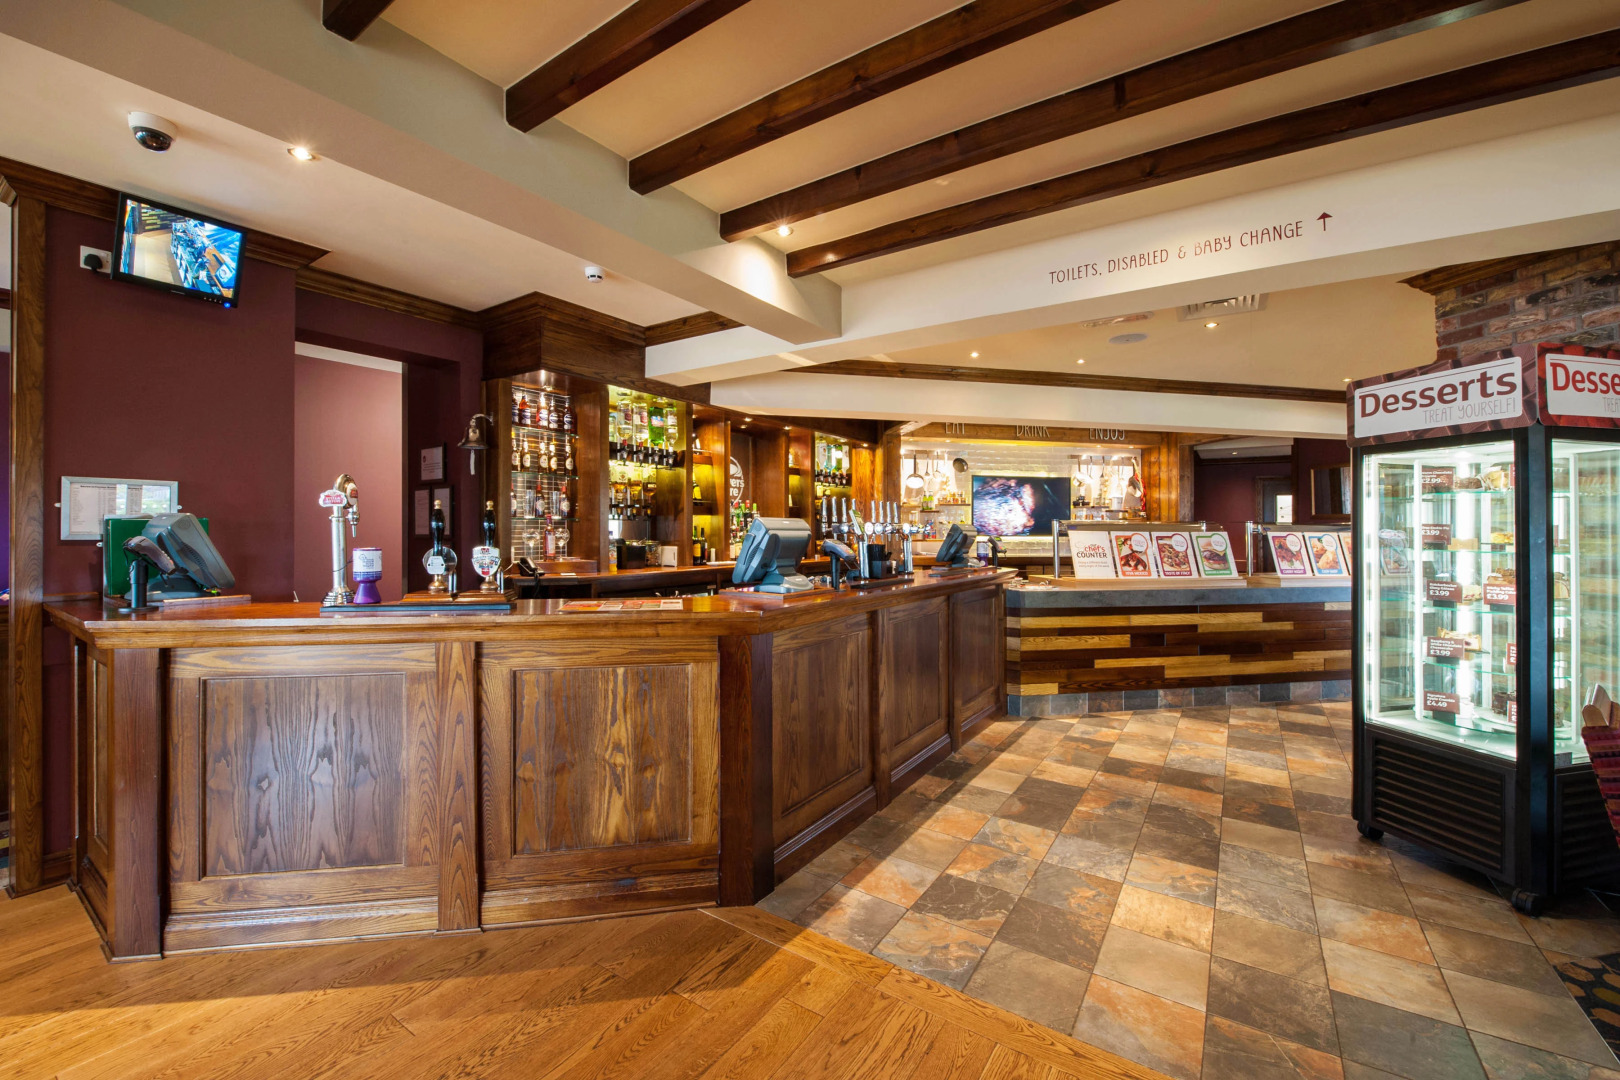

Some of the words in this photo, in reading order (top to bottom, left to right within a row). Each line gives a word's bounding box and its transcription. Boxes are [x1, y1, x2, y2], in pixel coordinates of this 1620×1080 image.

[1049, 262, 1102, 285] TOILETS,
[1108, 248, 1169, 273] DISABLED
[1177, 245, 1187, 259] &
[1194, 235, 1232, 257] BABY
[1240, 220, 1303, 247] CHANGE
[1358, 370, 1518, 418] Desserts
[1423, 406, 1453, 425] TREAT
[1457, 397, 1517, 420] YOURSELF!
[1016, 424, 1050, 438] DRINK
[1089, 427, 1126, 441] ENJOY
[1426, 700, 1448, 708] £4.49
